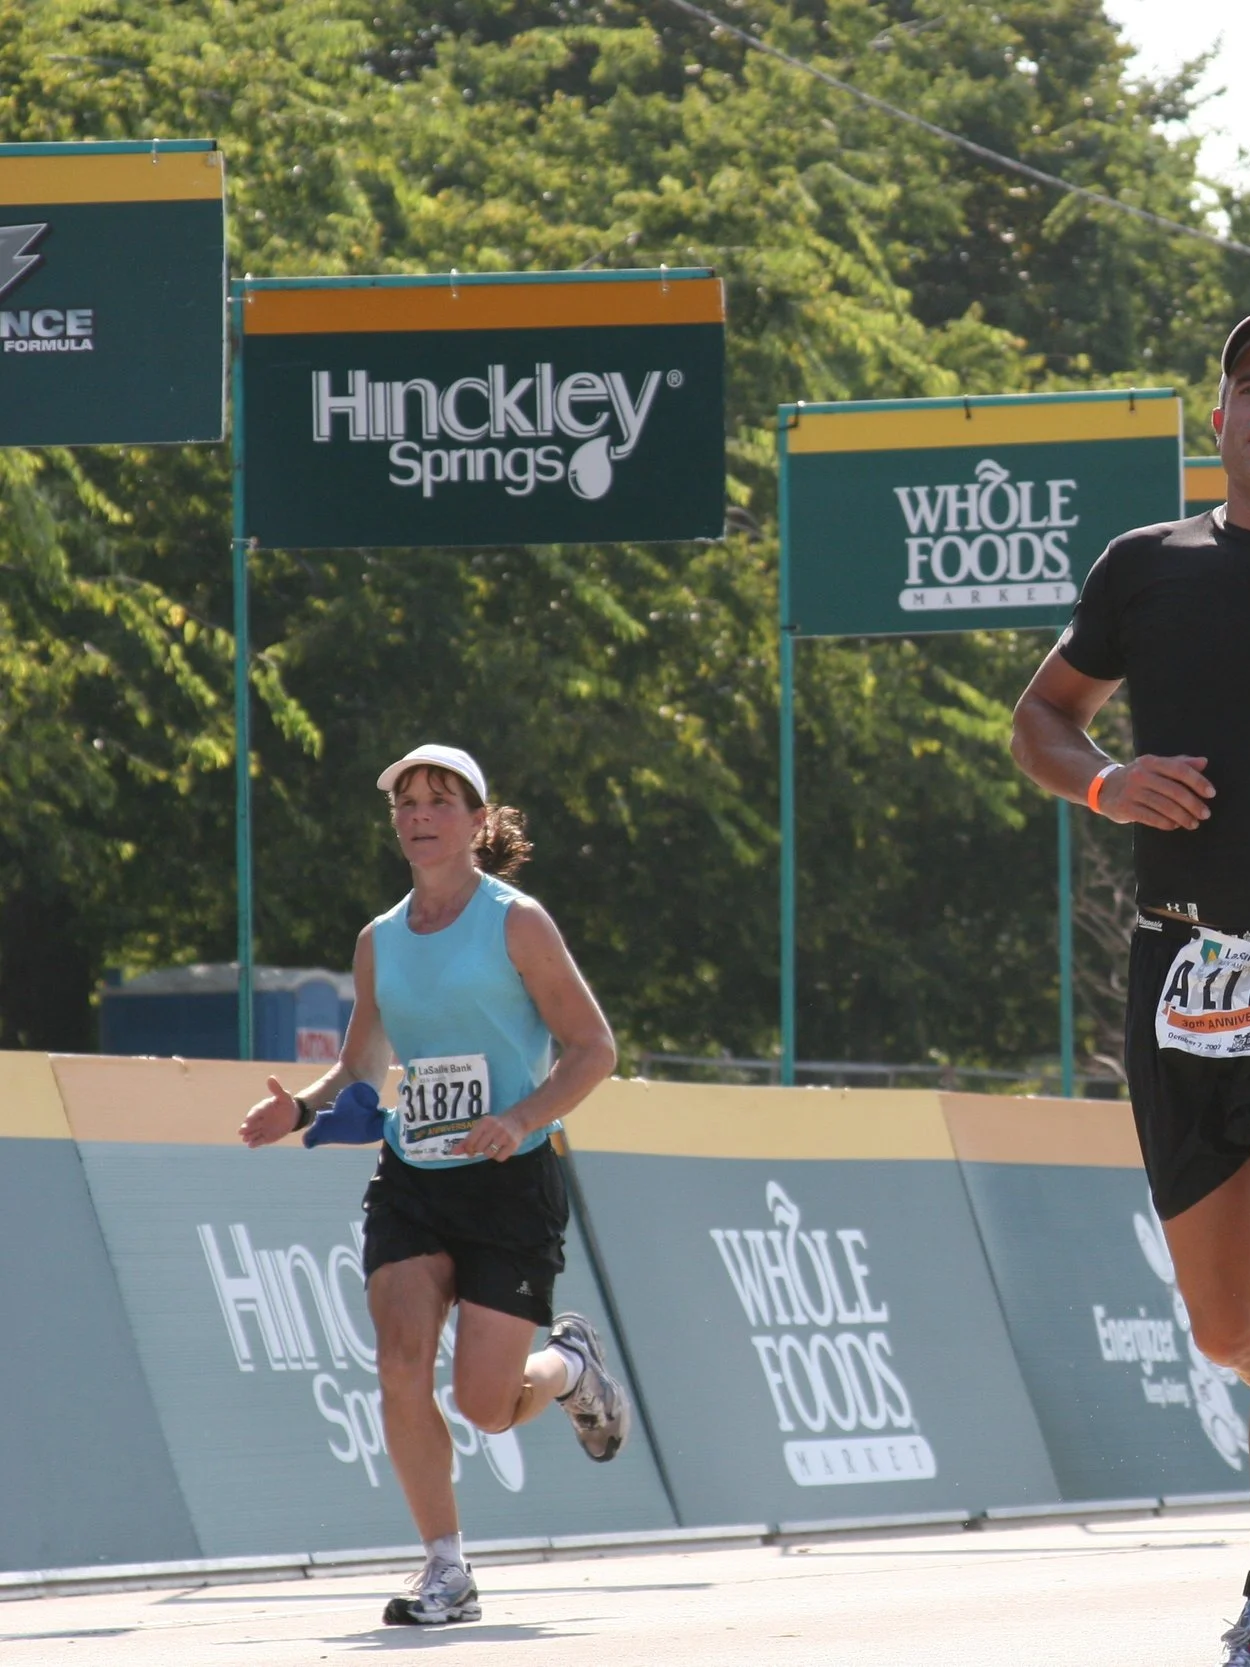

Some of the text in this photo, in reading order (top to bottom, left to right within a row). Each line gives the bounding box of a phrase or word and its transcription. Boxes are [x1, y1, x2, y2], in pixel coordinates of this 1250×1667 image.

[4, 339, 94, 353] FORMULA
[312, 362, 662, 460] Hinckley
[389, 441, 565, 498] Springs
[893, 468, 1079, 534] WHOLE
[904, 531, 1071, 585] FOODS
[912, 586, 1064, 605] MARKET
[418, 1063, 473, 1076] LaSalle Bank
[402, 1079, 482, 1123] 31878
[430, 1121, 477, 1134] ANNIVERSA
[709, 1206, 889, 1328] WHOLE
[197, 1220, 382, 1374] Hinc
[751, 1331, 912, 1433] FOODS
[793, 1444, 925, 1477] MARKET
